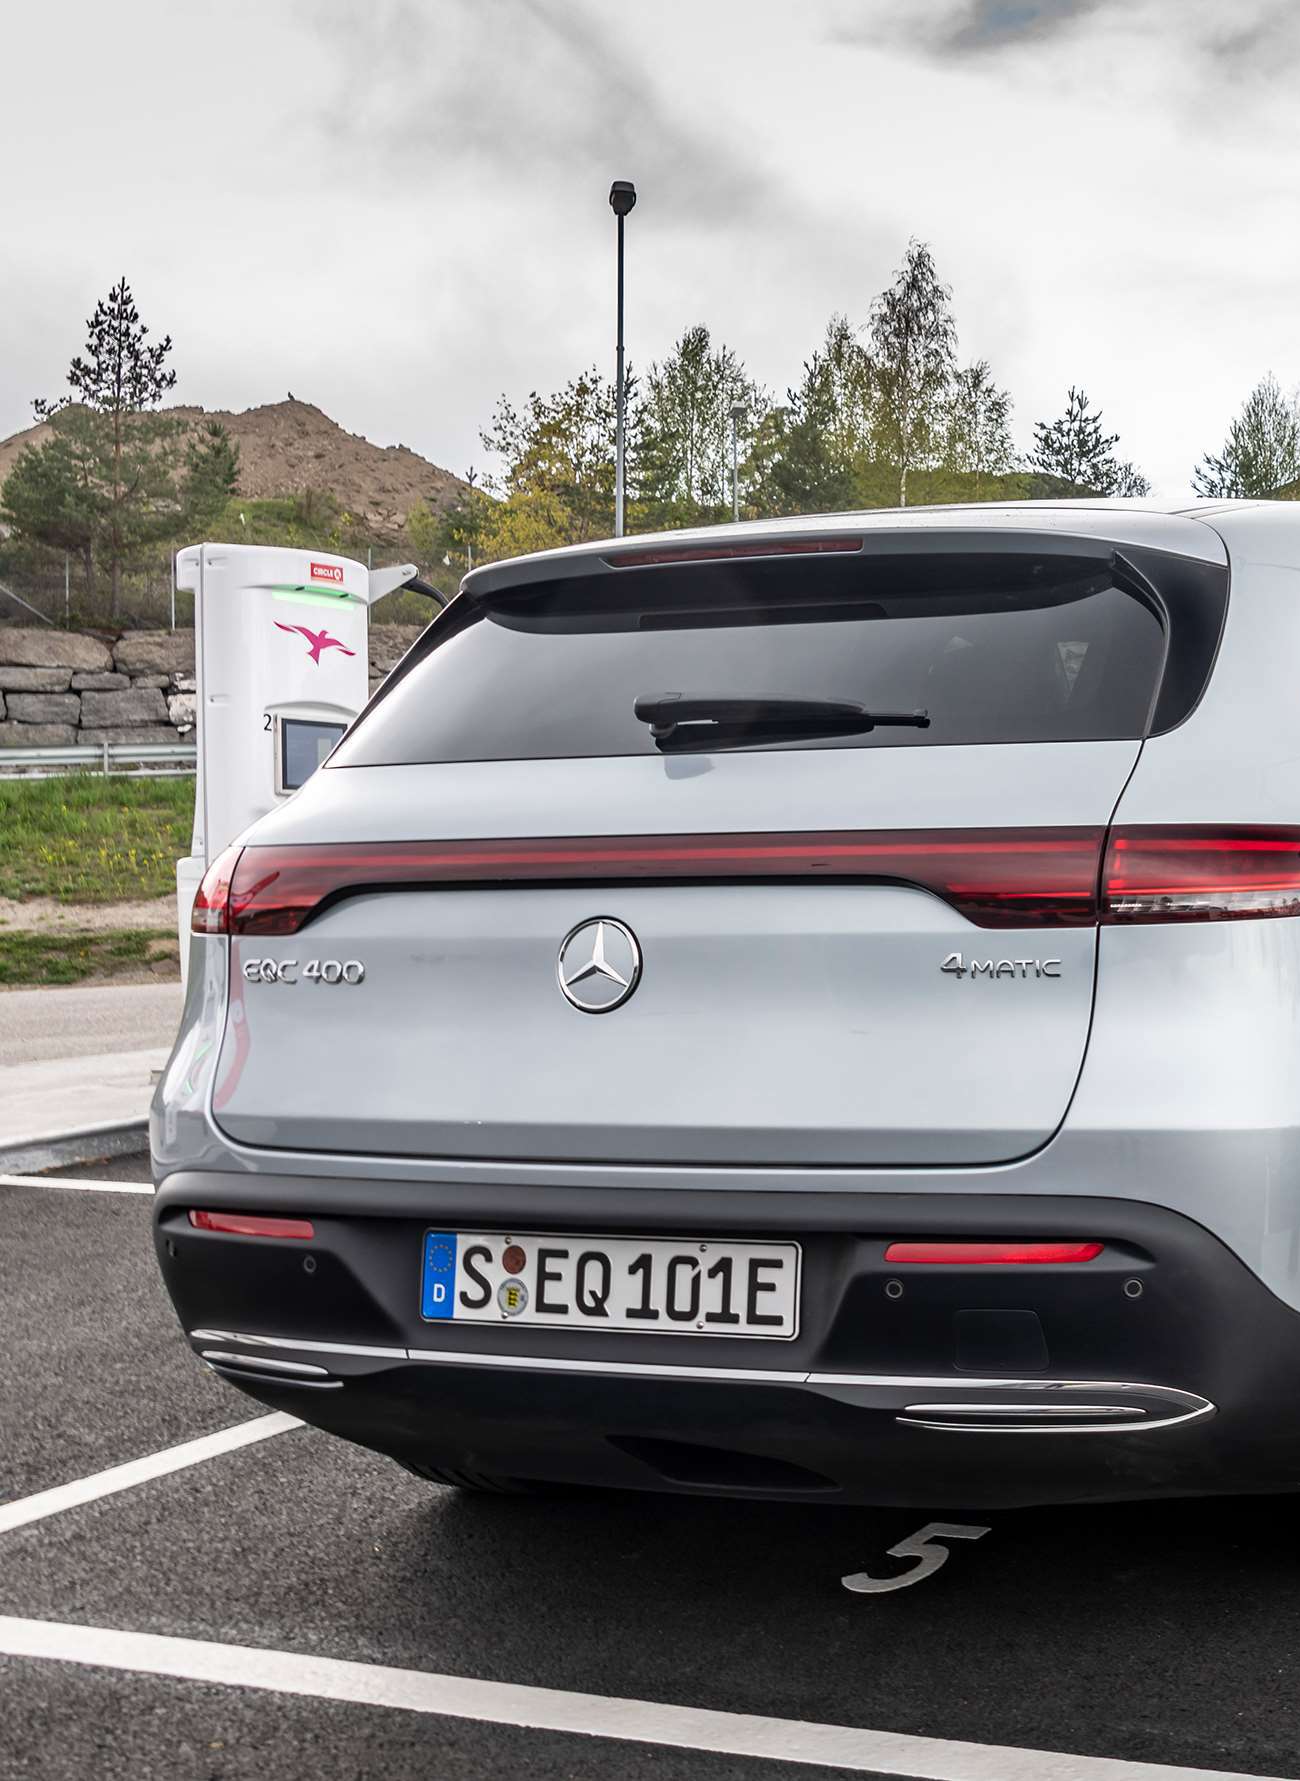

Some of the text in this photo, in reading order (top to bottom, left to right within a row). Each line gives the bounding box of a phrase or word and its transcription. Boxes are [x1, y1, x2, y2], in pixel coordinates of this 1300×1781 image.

[263, 713, 272, 731] 2
[243, 958, 367, 985] EQC 400
[940, 952, 1062, 979] 4MATIC
[433, 1283, 446, 1303] D
[459, 1245, 494, 1310] S
[535, 1248, 612, 1318] EQ
[624, 1252, 785, 1327] 101E
[841, 1522, 992, 1594] 5
